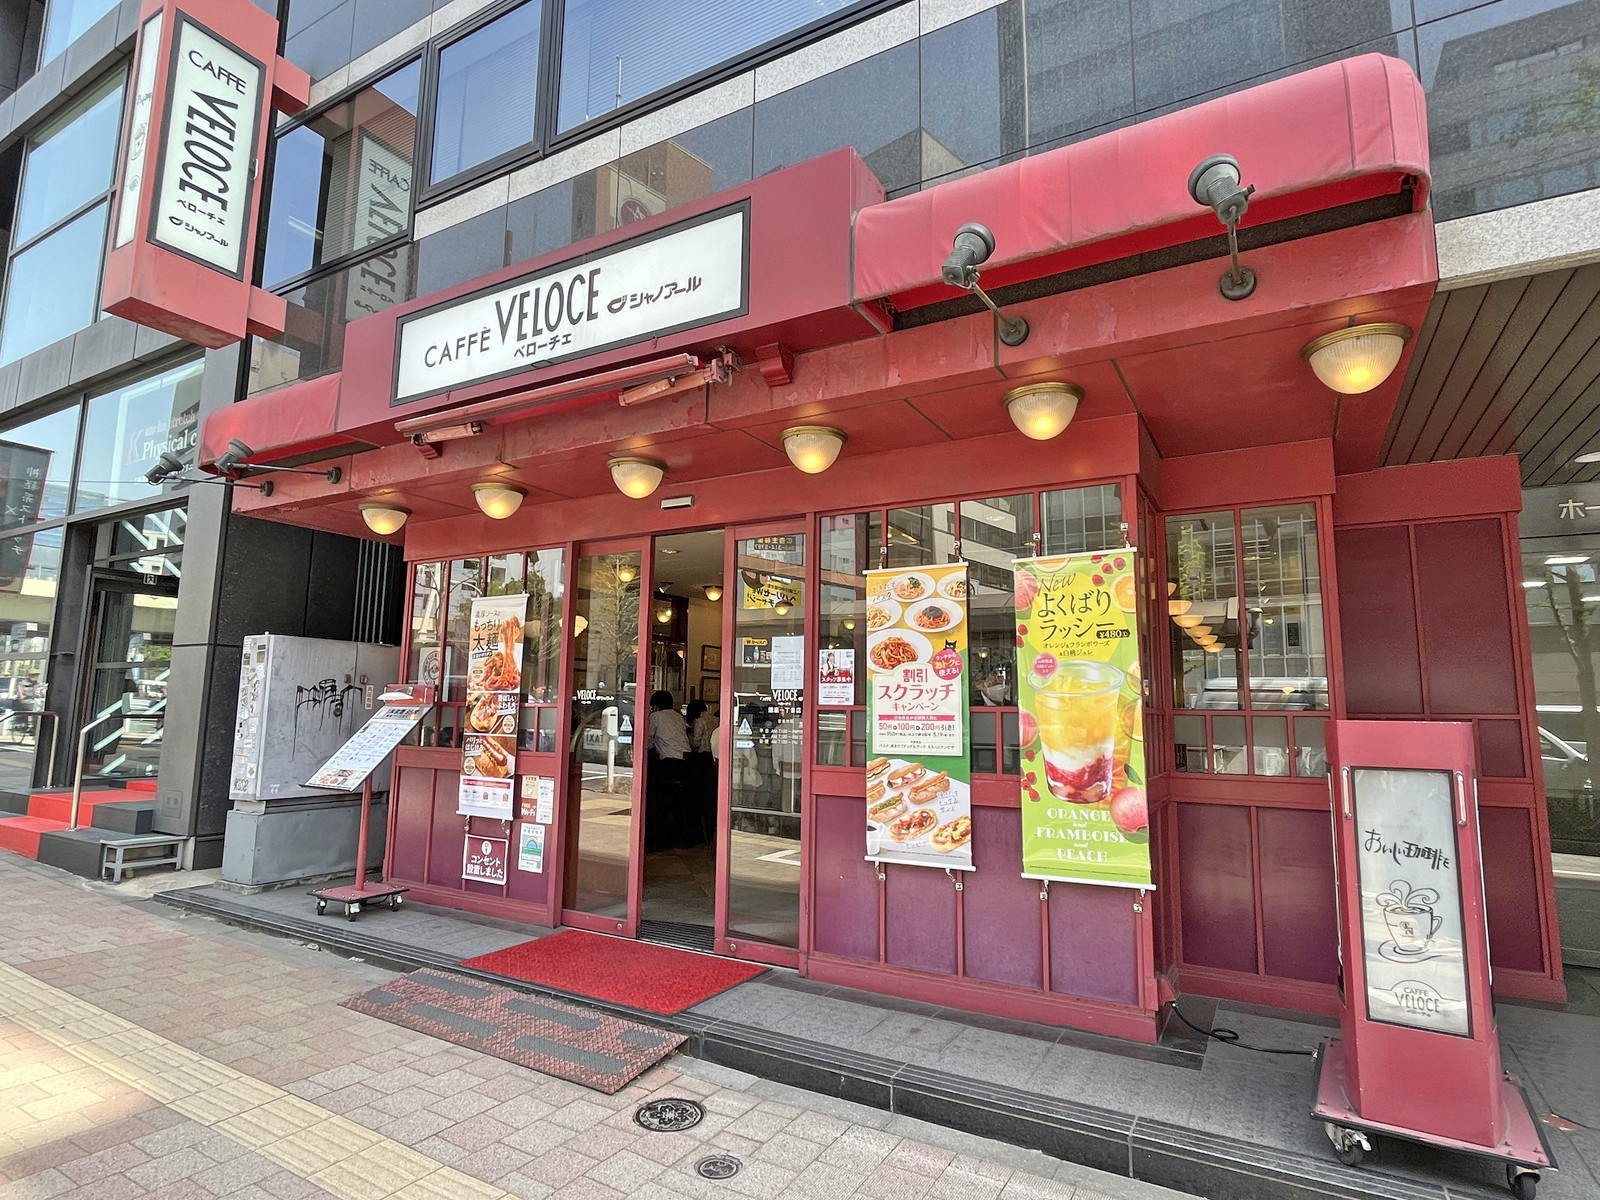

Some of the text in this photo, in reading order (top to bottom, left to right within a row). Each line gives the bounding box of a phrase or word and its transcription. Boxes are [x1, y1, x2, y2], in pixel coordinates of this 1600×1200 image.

[178, 88, 239, 211] VELOCE
[176, 198, 226, 226] ベローチェ
[184, 222, 229, 248] シャノアール
[629, 275, 702, 310] シャノアール
[494, 268, 602, 345] VELOCE
[513, 333, 572, 359] ベローチェ
[142, 429, 189, 461] Physical
[1038, 573, 1077, 597] New
[1037, 589, 1112, 619] よくばり
[474, 618, 501, 632] もっちり
[1039, 617, 1115, 642] ラッシー
[472, 632, 499, 652] 太麺
[934, 660, 961, 670] おトクに
[903, 668, 928, 683] 割引
[577, 689, 597, 701] VELOCE
[772, 689, 798, 702] VELOCE
[878, 683, 956, 701] スクラッチ
[892, 702, 939, 712] キャンペーン
[1047, 808, 1111, 822] ORANGE
[470, 854, 501, 868] コンセント
[1057, 848, 1108, 863] PEACH
[466, 863, 504, 879] 設置しました
[1394, 991, 1441, 1014] VELOCE
